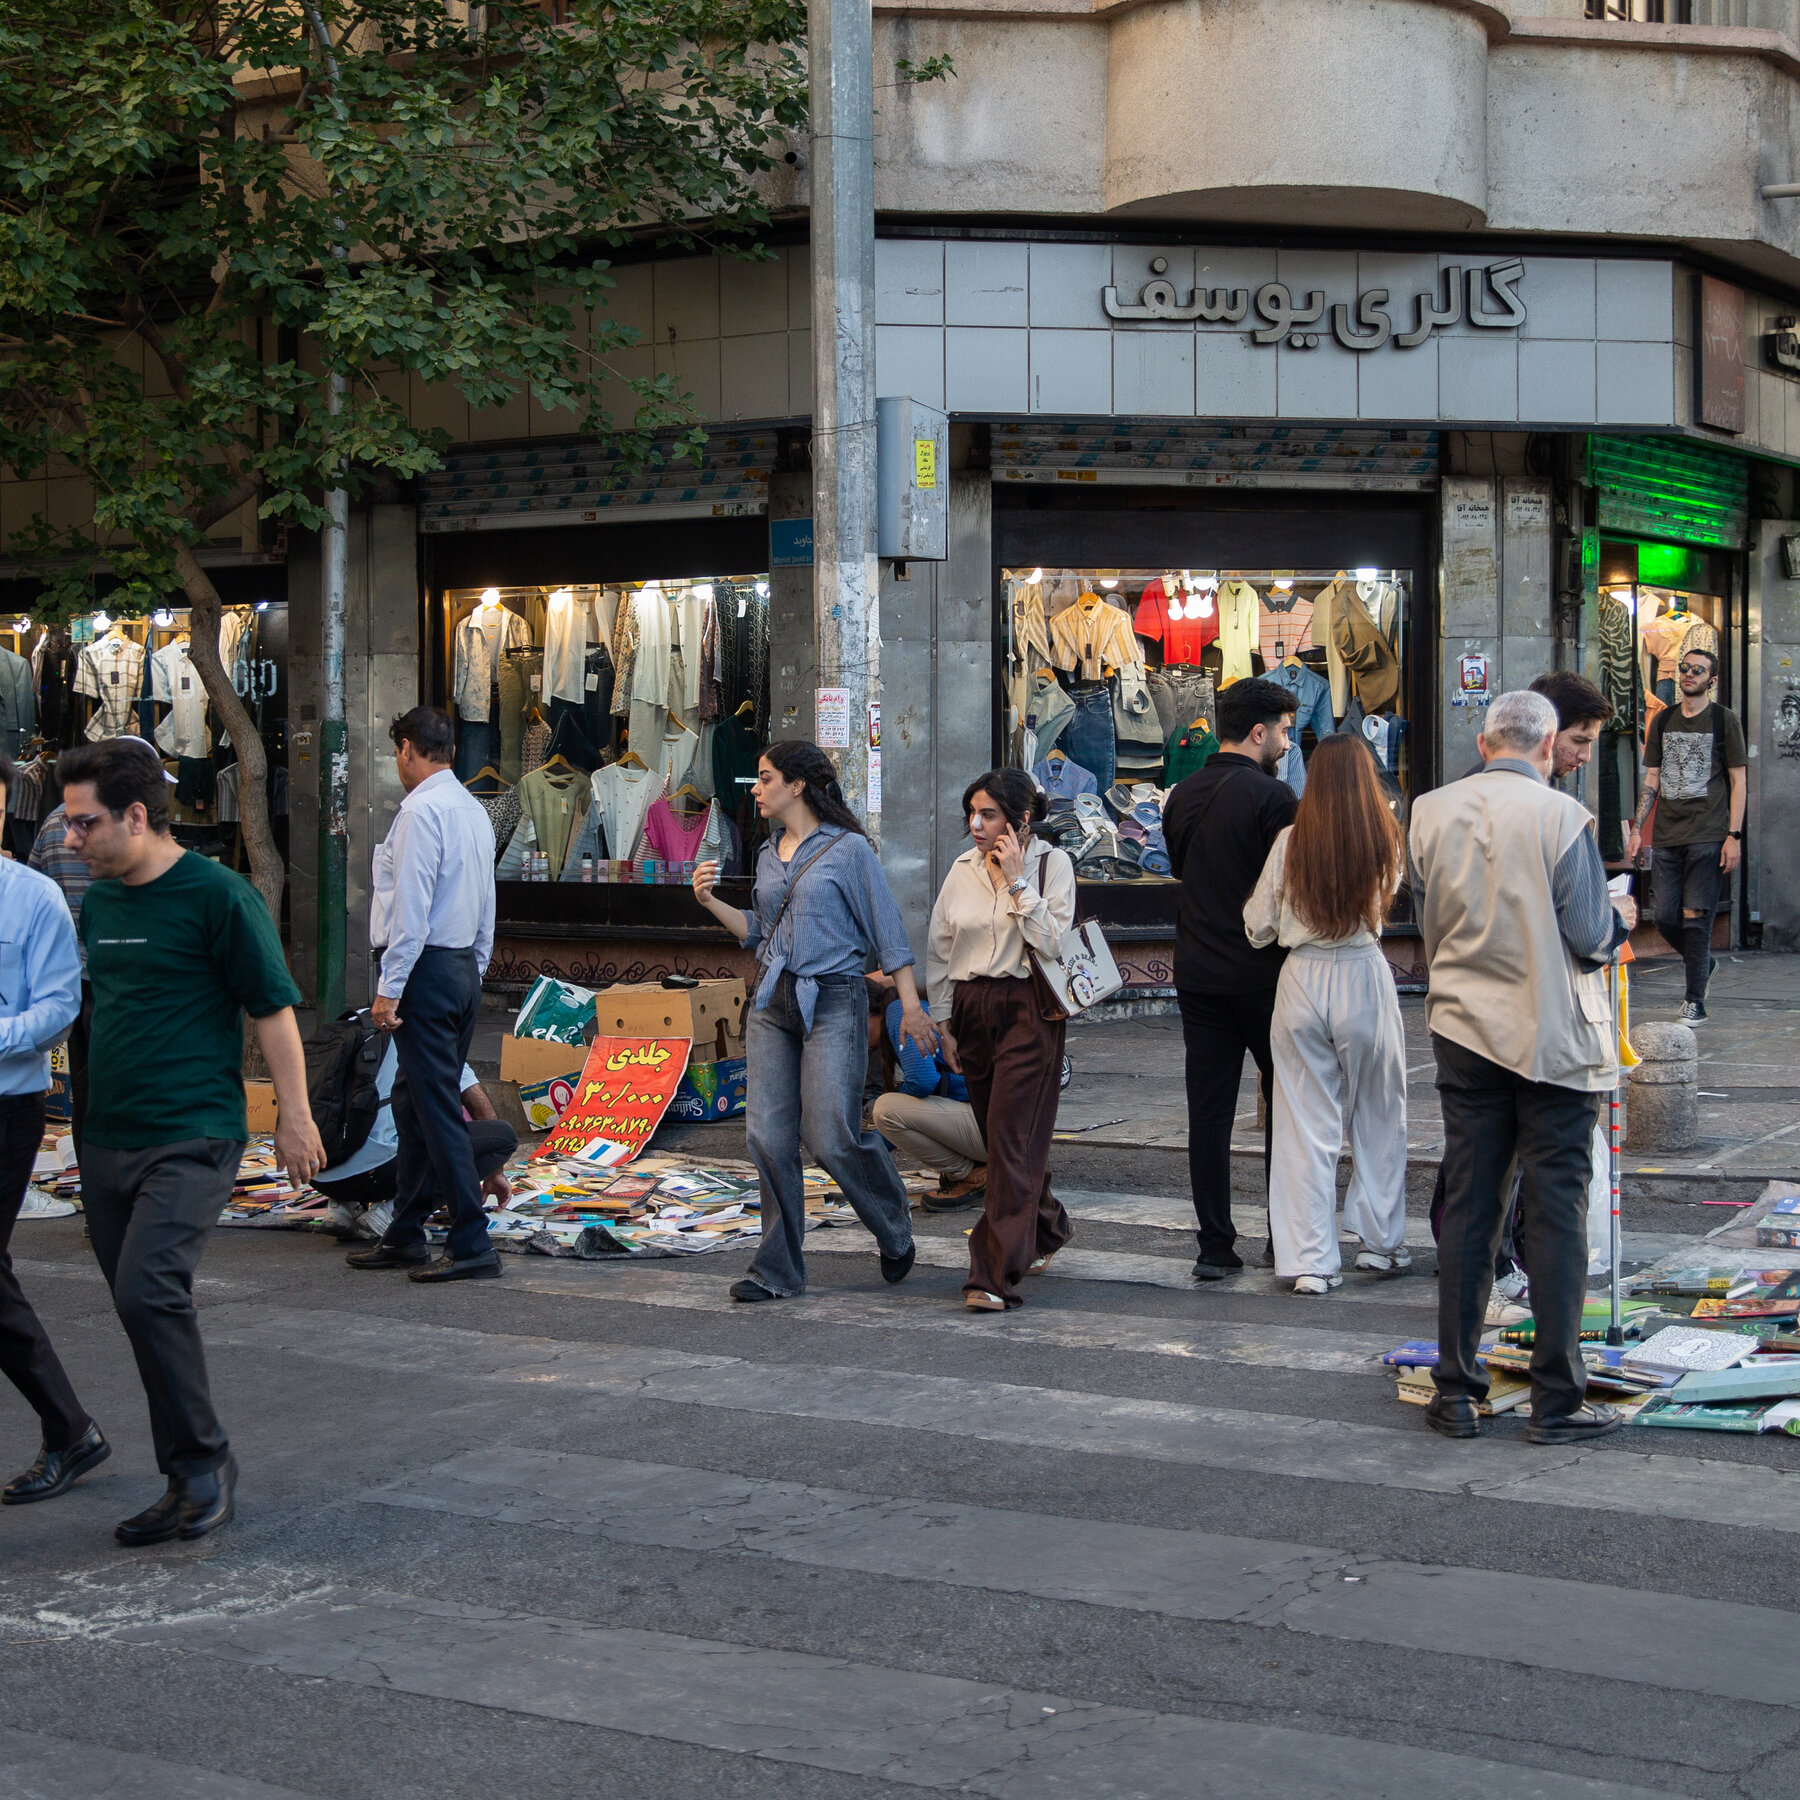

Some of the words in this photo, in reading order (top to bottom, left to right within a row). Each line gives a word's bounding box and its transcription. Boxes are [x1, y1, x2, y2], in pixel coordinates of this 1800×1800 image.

[1102, 257, 1325, 348] یوسف
[1332, 256, 1527, 350] گالری
[605, 1039, 672, 1073] جلدی
[581, 1080, 664, 1108] ۳۰/۰۰۰
